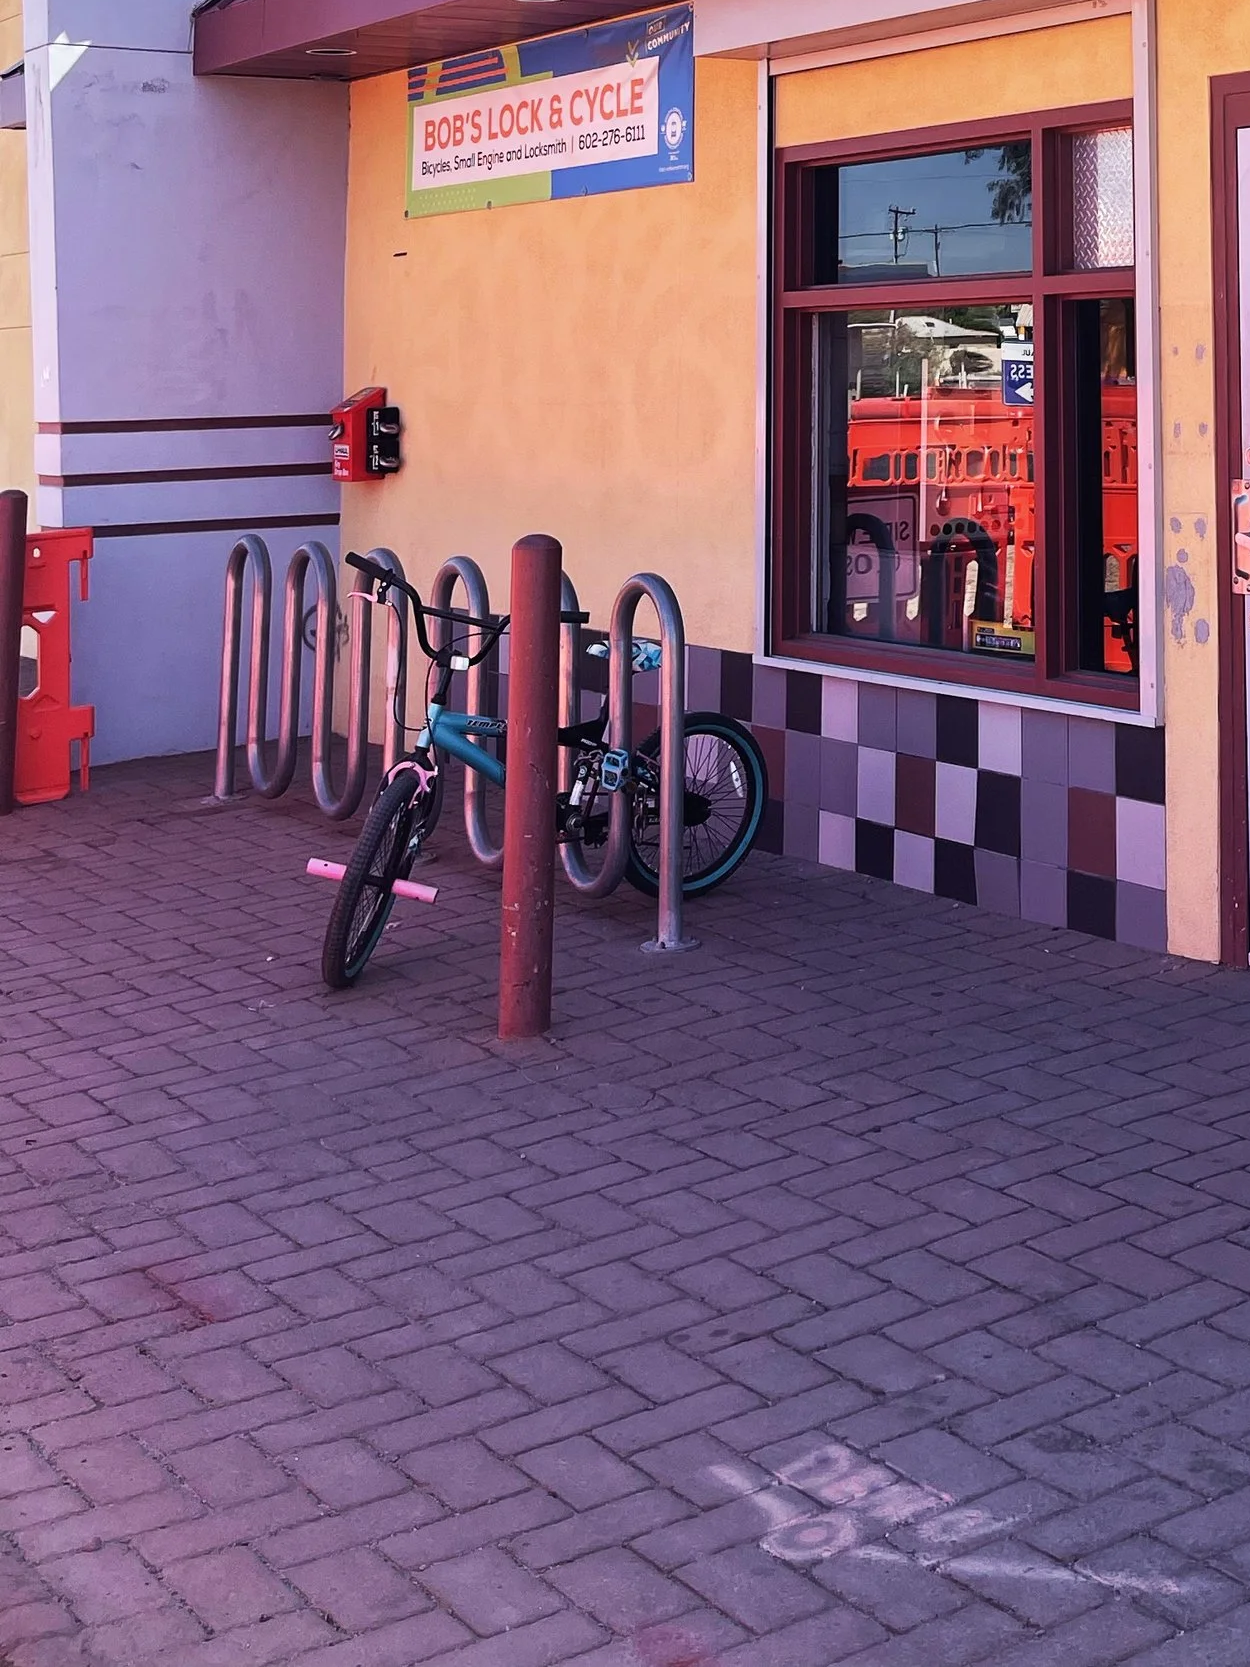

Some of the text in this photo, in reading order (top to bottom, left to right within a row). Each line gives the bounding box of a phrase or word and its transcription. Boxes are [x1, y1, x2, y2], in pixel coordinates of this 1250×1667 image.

[647, 21, 690, 51] COMMUNITY
[424, 78, 644, 152] BOB'S LOCK & CYCLE
[421, 158, 452, 179] Bicycles,
[454, 153, 476, 171] Small
[477, 149, 505, 171] Engine
[506, 145, 522, 163] and
[524, 137, 567, 160] Locksmith
[578, 124, 646, 151] 602-276-6111
